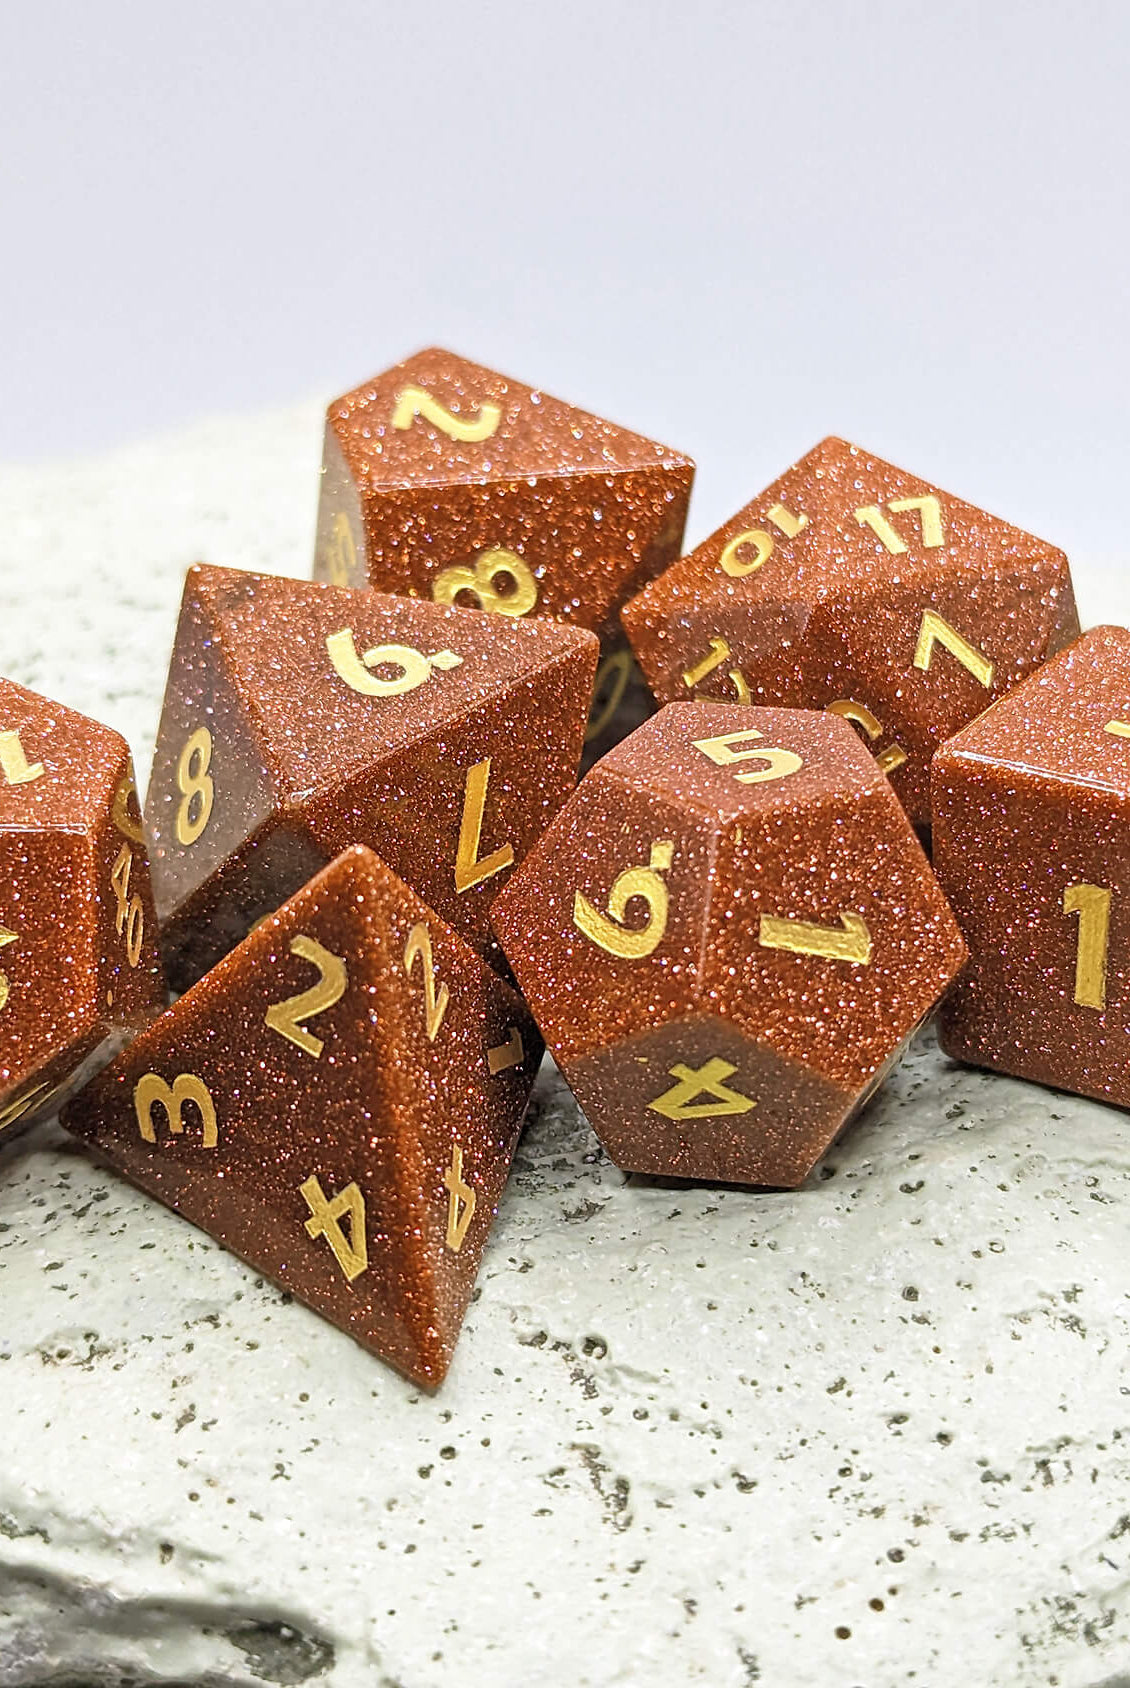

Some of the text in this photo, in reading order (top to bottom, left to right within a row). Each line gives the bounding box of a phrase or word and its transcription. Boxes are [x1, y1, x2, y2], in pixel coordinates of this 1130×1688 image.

[853, 496, 945, 554] 17
[913, 609, 992, 688] 7
[176, 726, 214, 846] 8
[691, 729, 803, 784] 5
[454, 757, 514, 894] 7
[403, 922, 450, 1042] 2
[760, 912, 872, 966] 1
[1063, 884, 1112, 1011] 1
[264, 935, 347, 1058] 2
[134, 1072, 218, 1149] 3
[648, 1057, 757, 1120] 4
[300, 1174, 369, 1282] 4
[444, 1144, 477, 1252] 4
